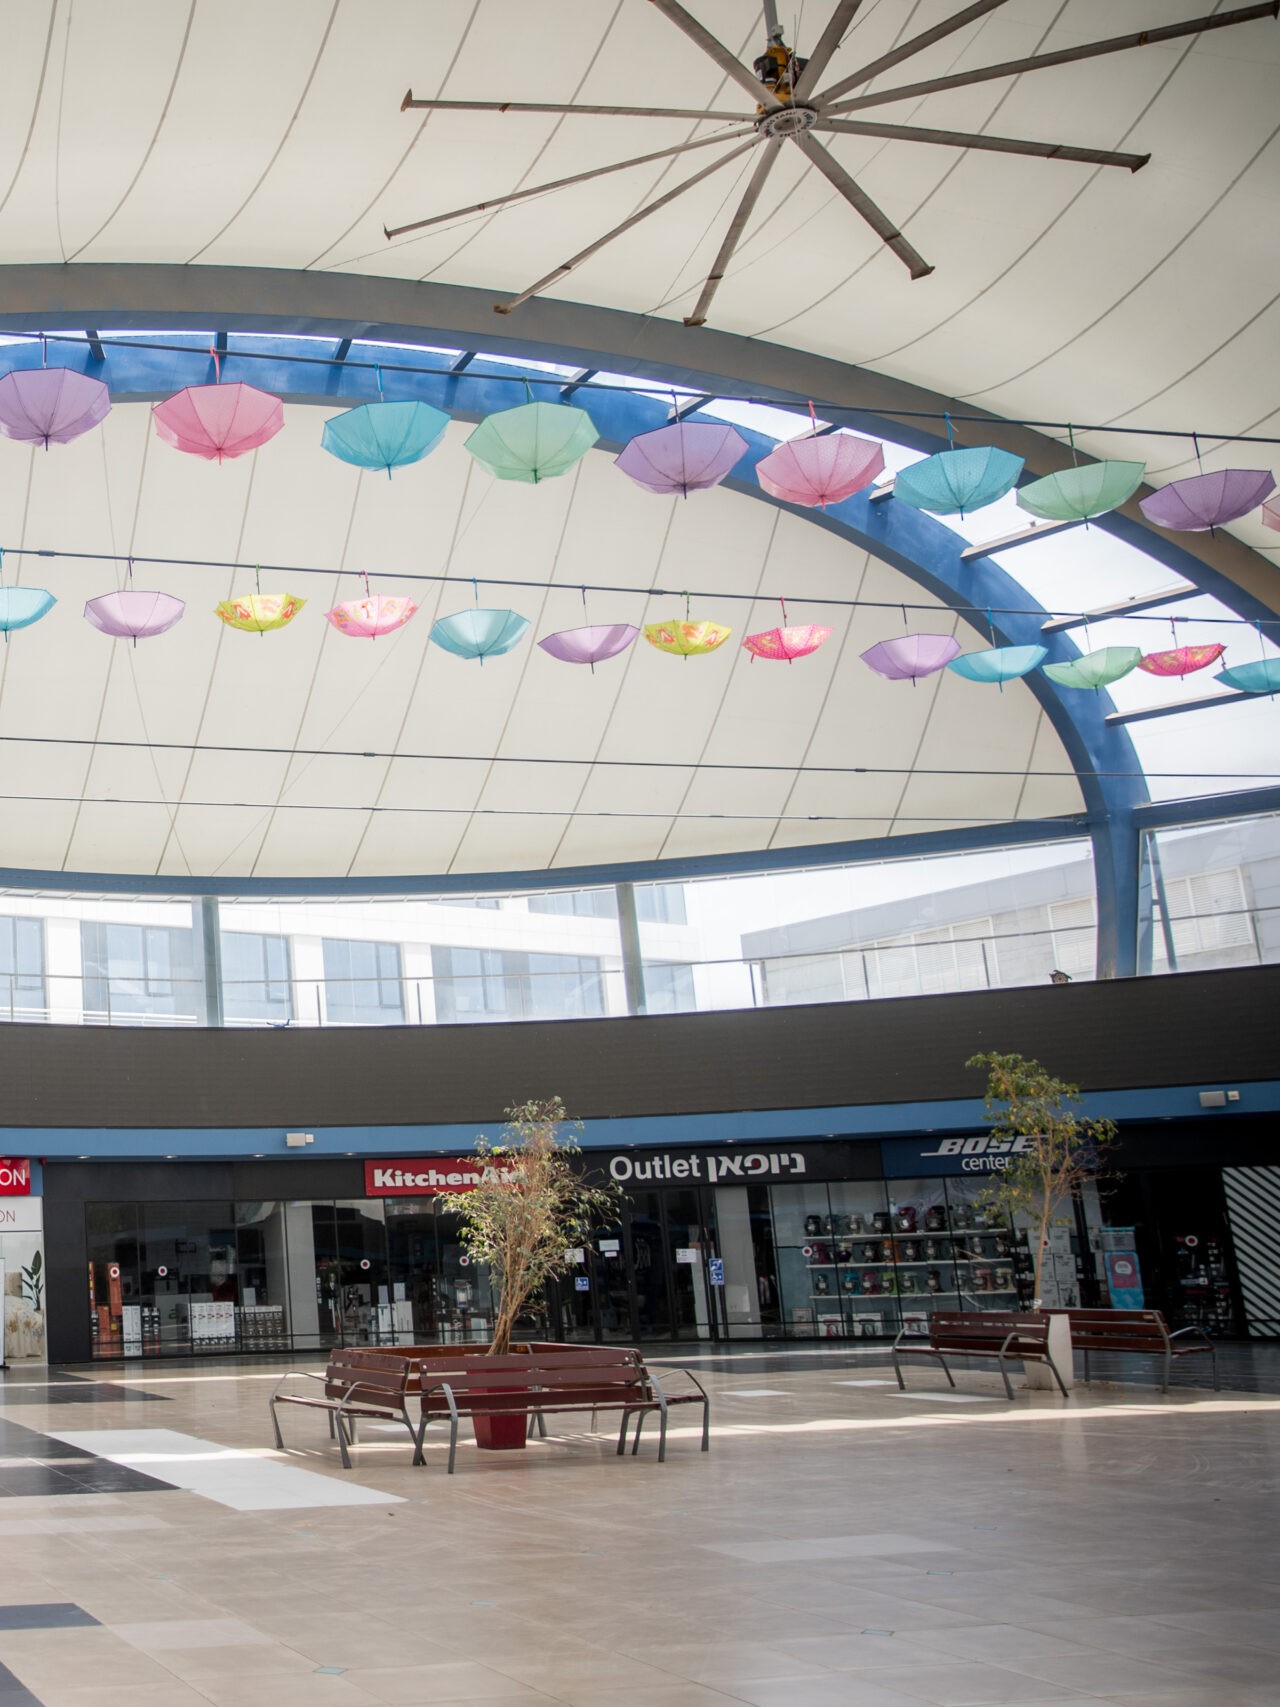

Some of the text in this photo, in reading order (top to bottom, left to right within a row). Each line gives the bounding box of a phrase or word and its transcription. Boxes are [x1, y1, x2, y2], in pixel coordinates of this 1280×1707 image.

[920, 1135, 1048, 1156] BOSE
[610, 1153, 806, 1182] Outlet ניופאן
[962, 1155, 1010, 1171] center
